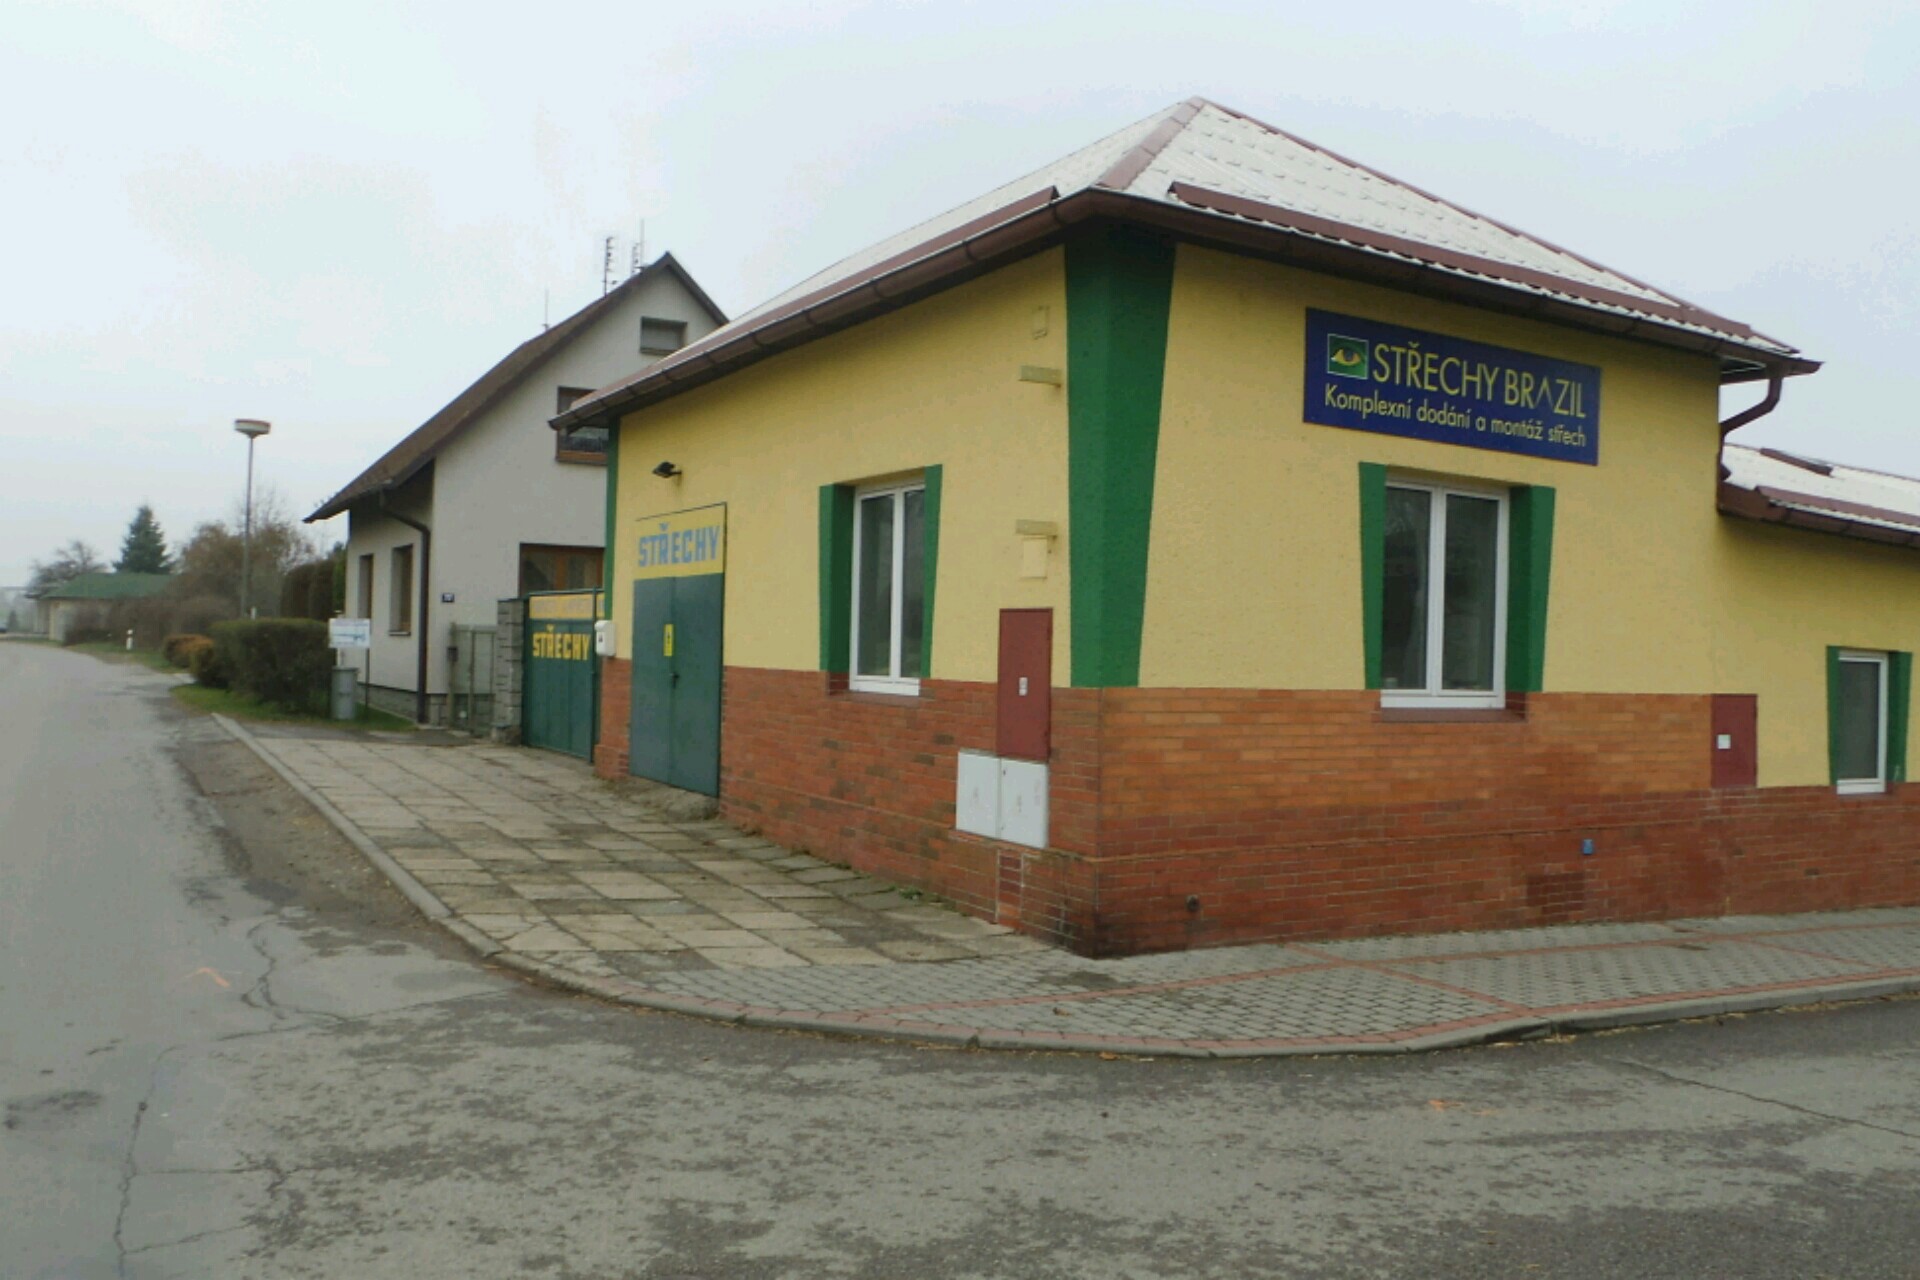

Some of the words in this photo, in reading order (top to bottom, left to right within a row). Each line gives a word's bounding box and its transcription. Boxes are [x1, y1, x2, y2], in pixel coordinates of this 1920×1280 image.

[1373, 341, 1499, 402] STŘECHY
[1505, 369, 1586, 418] BRAZIL
[1325, 383, 1411, 420] Komplexní
[1416, 399, 1471, 430] dodání
[1475, 416, 1486, 431] a
[1491, 418, 1544, 440] montáž
[1548, 424, 1586, 447] střech
[638, 522, 720, 567] STŘECHY
[533, 624, 591, 660] STŘECHY
